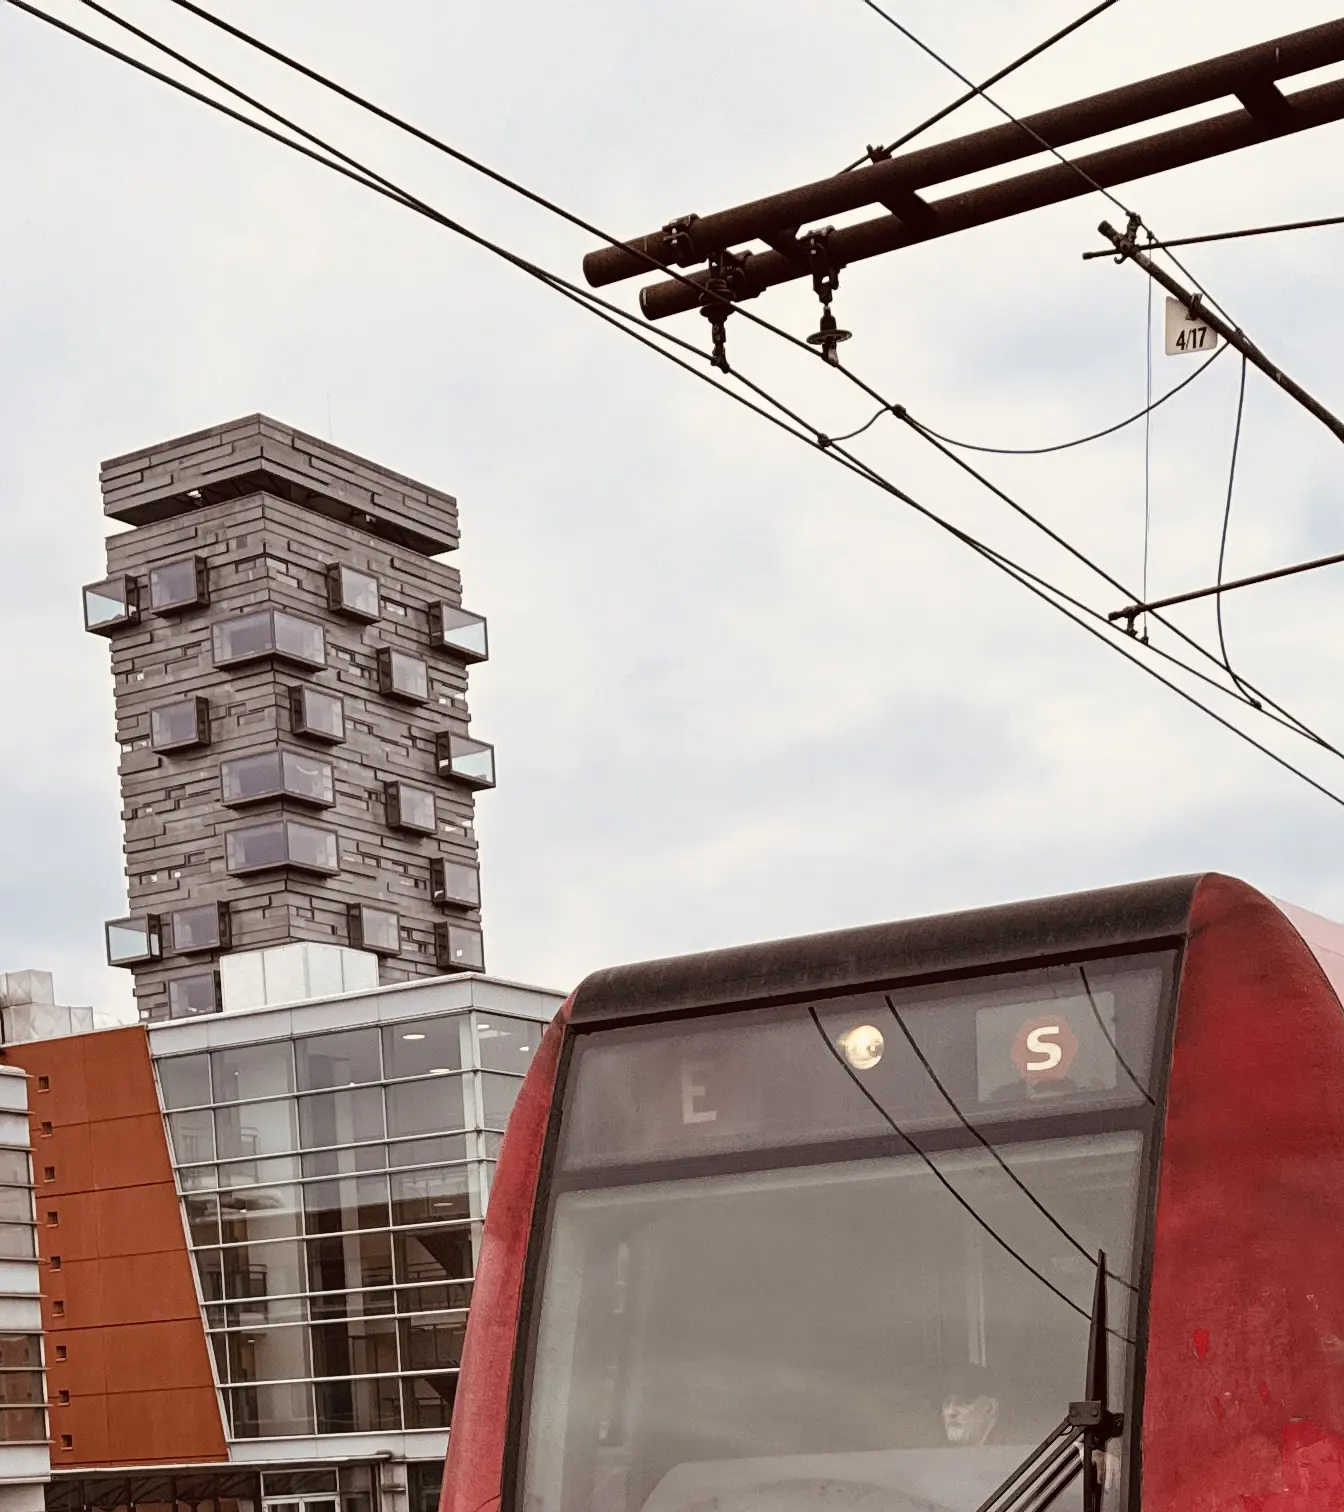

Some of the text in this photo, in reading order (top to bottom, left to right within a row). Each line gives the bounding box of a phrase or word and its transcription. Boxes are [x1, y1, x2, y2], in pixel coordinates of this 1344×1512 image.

[1175, 326, 1207, 351] 4/17
[1026, 1026, 1062, 1071] S
[682, 1064, 717, 1124] E
